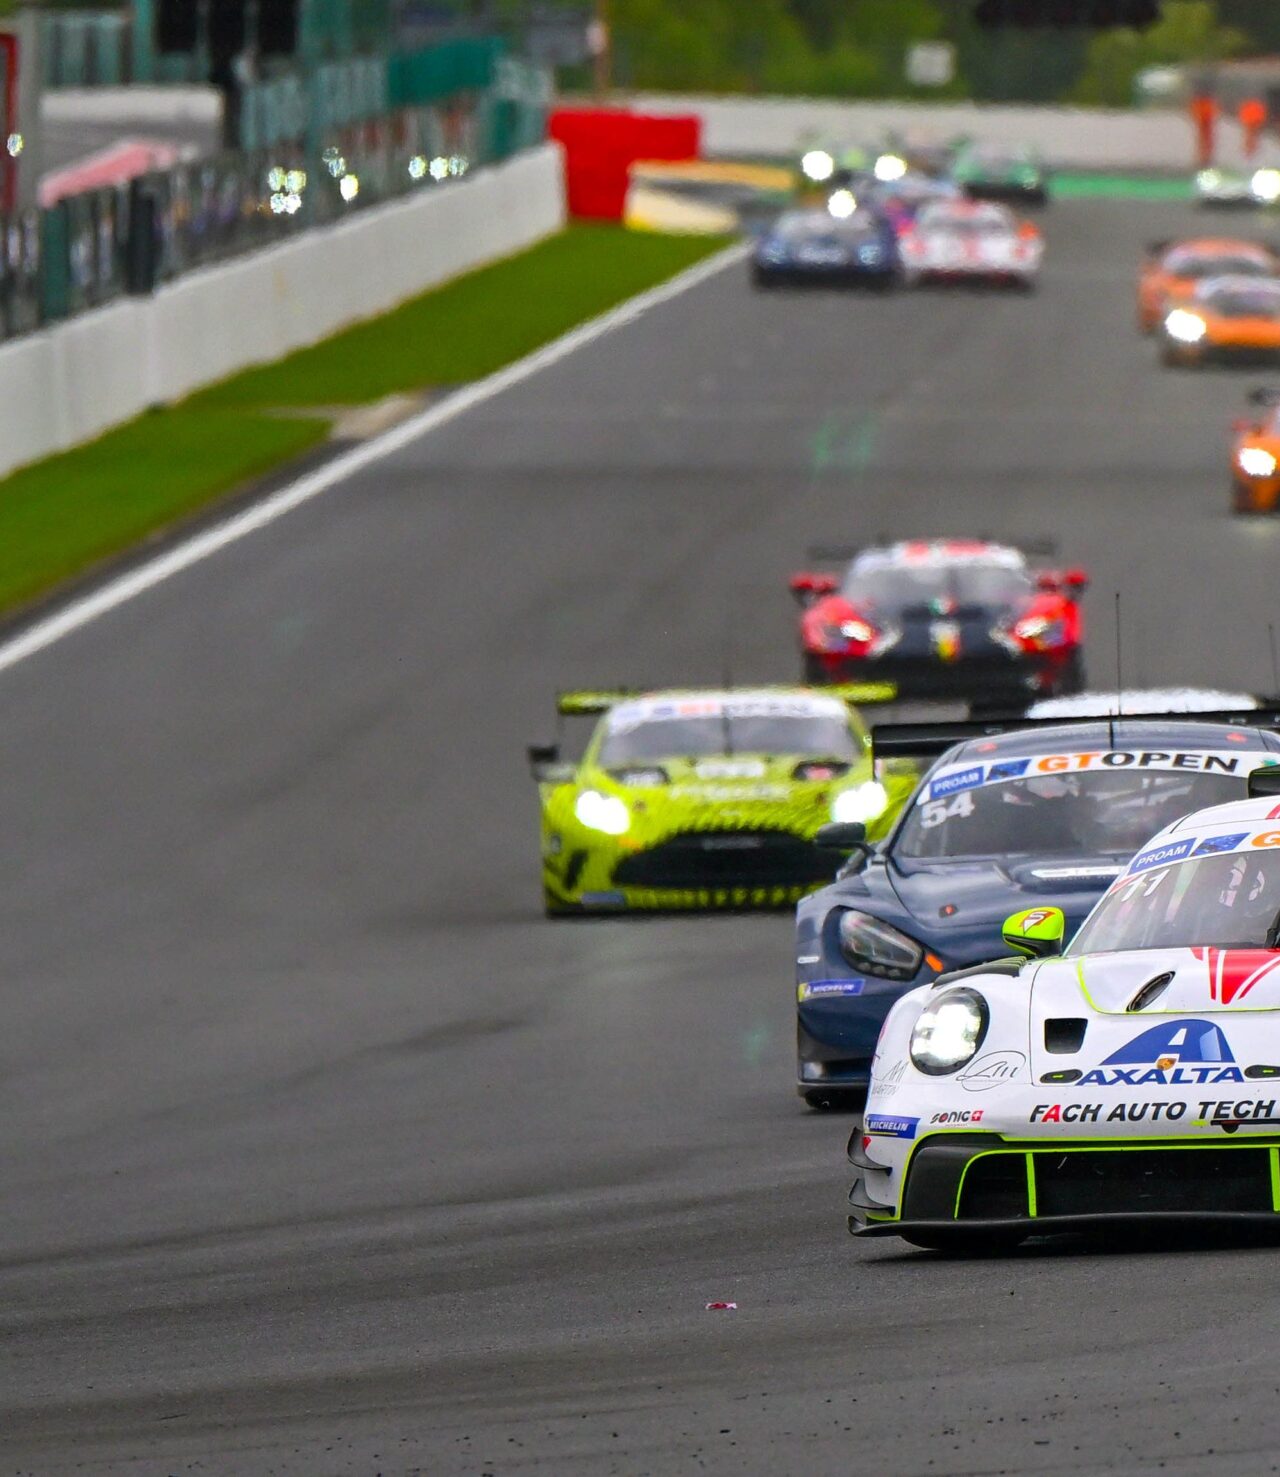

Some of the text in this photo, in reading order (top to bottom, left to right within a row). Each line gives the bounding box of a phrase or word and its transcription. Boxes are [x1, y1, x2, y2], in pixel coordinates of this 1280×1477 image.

[934, 772, 980, 793] PROAM
[921, 791, 976, 829] 54
[1136, 845, 1188, 868] PROAM
[1121, 869, 1170, 902] 11
[1075, 1066, 1246, 1087] AXALTA
[1029, 1100, 1276, 1123] FACH AUTO TECH
[870, 1121, 909, 1131] MICHELIN
